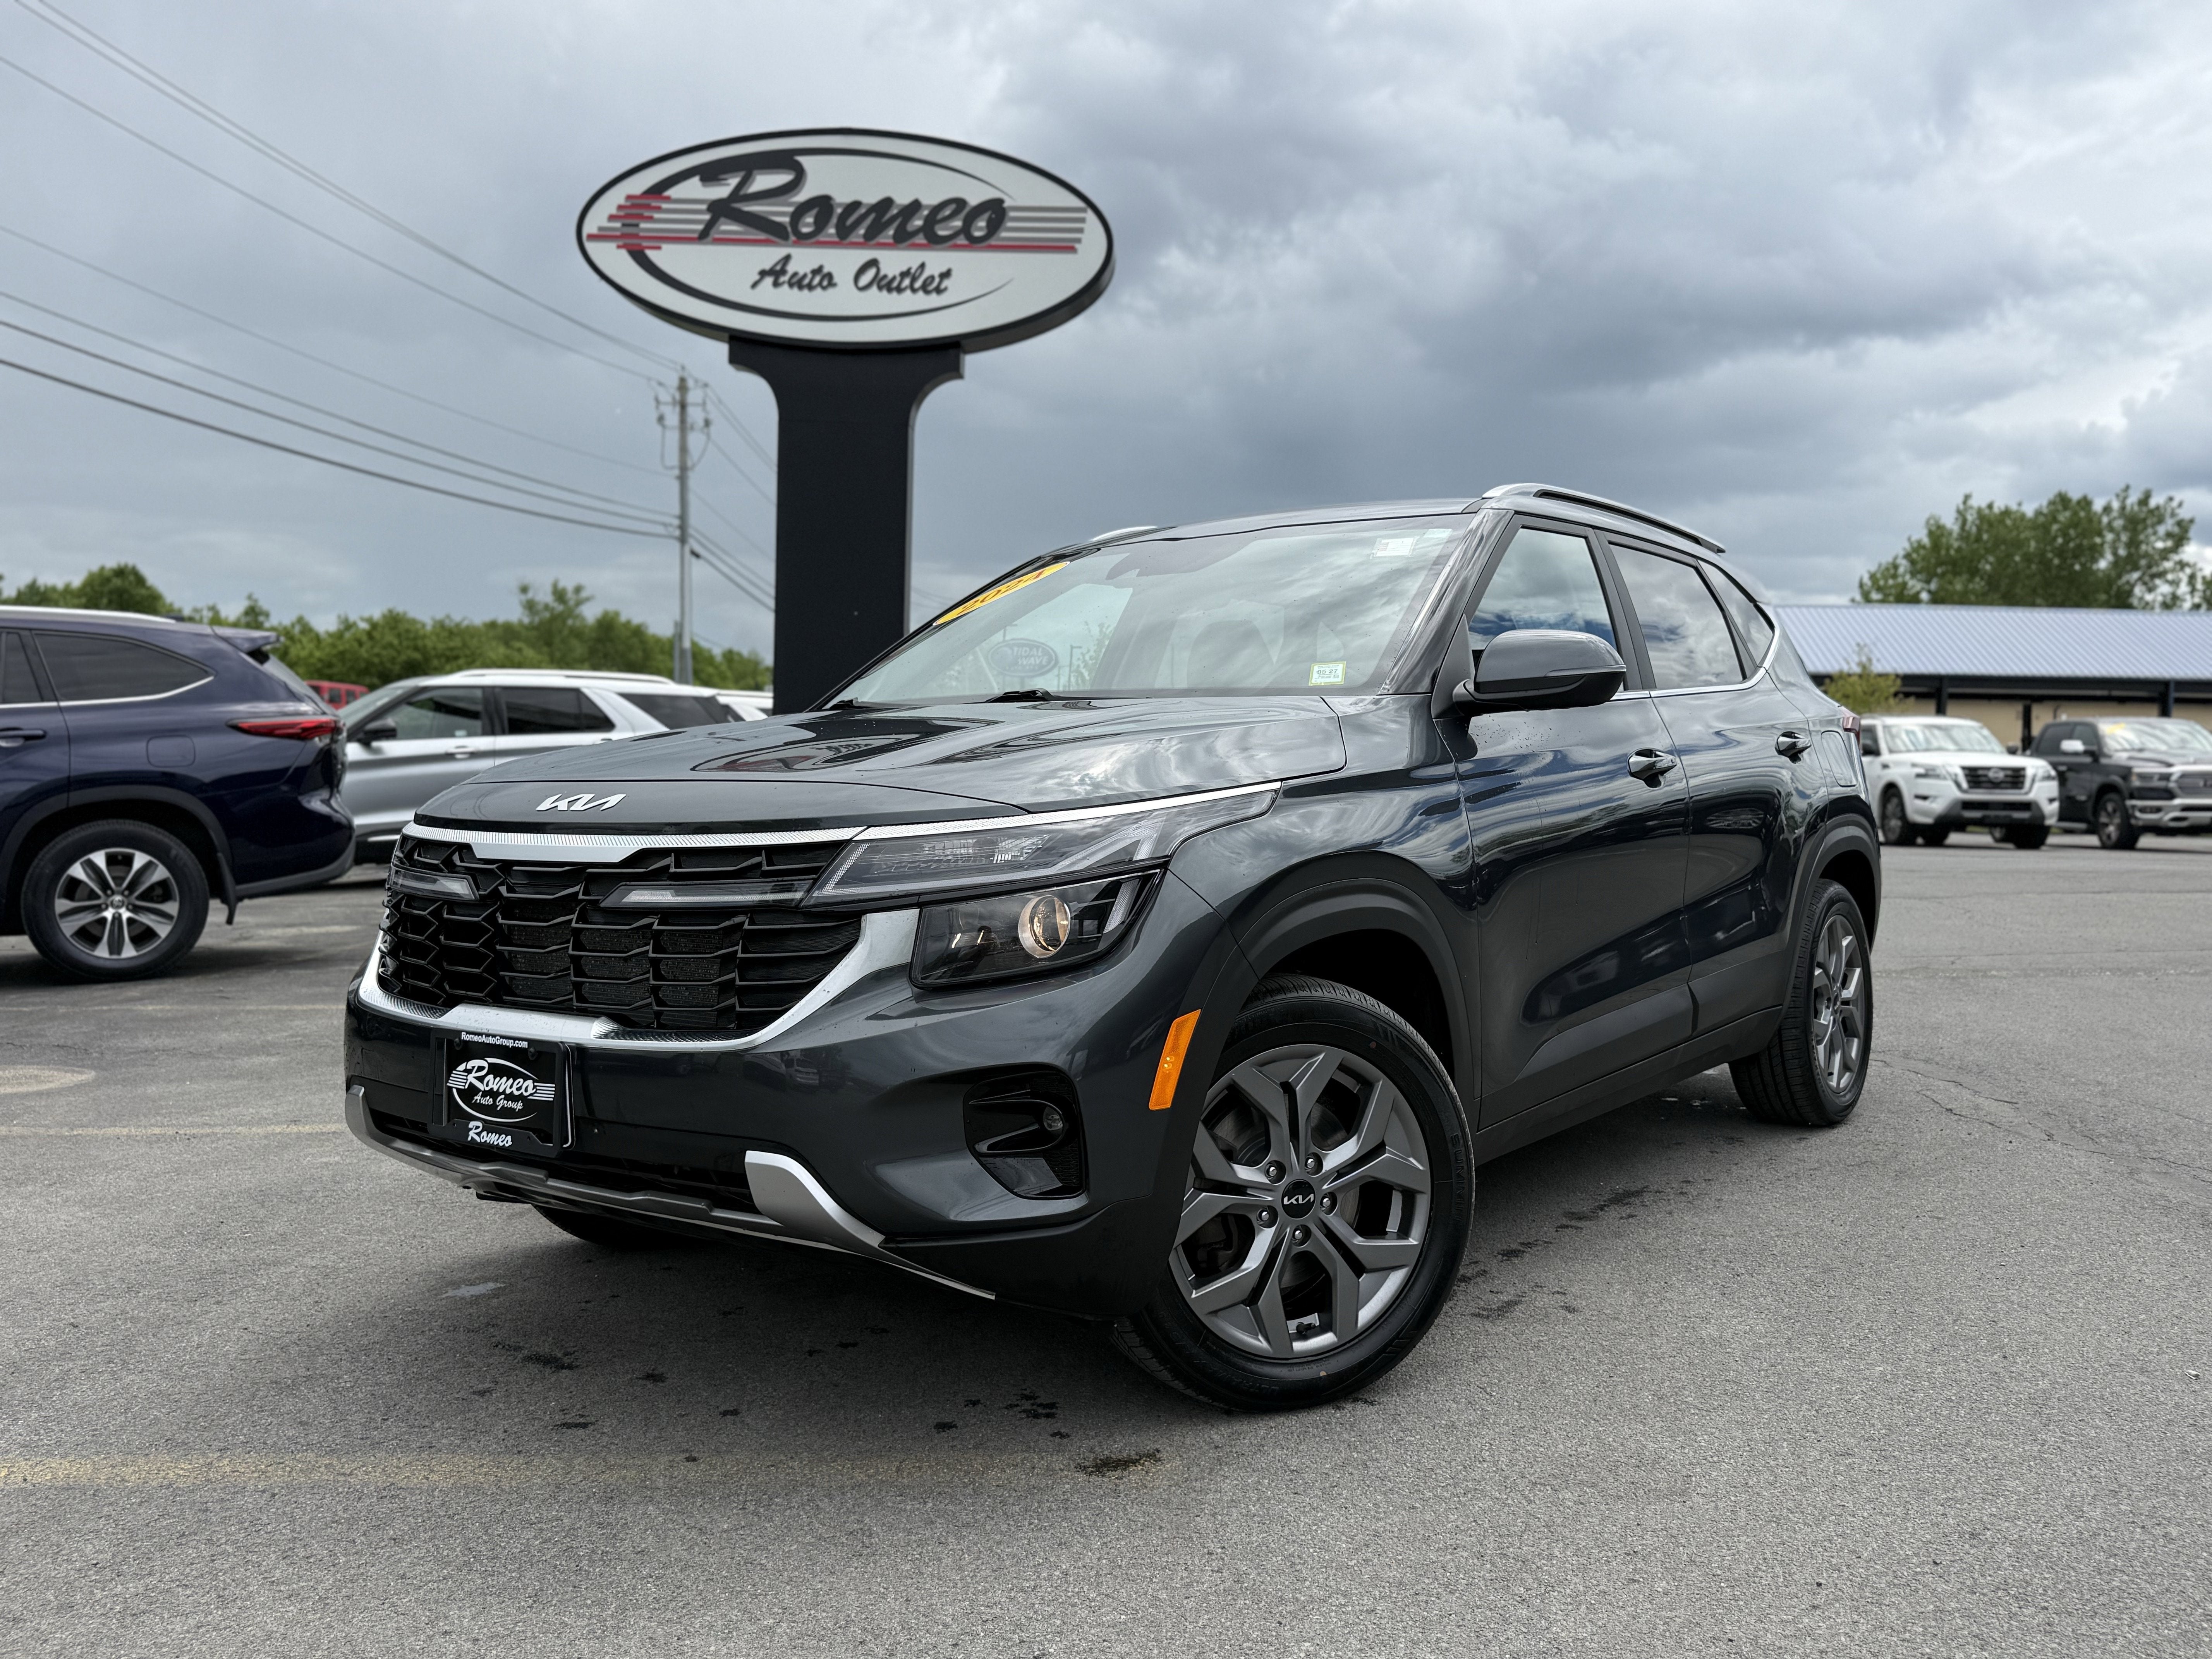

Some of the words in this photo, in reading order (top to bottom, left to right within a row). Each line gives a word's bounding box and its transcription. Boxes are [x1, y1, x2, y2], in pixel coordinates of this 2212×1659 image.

[697, 155, 1006, 245] Romeo
[750, 253, 838, 292] Auto
[854, 258, 952, 295] Outlet
[957, 569, 1046, 615] 2024
[1013, 646, 1042, 656] TIDAL
[1018, 656, 1048, 665] WAVE
[461, 1032, 528, 1049] RomeoAutoGroup.com
[465, 1059, 536, 1096] Romeo
[472, 1091, 493, 1104] Auto
[496, 1095, 524, 1112] Group
[467, 1121, 512, 1147] Romeo
